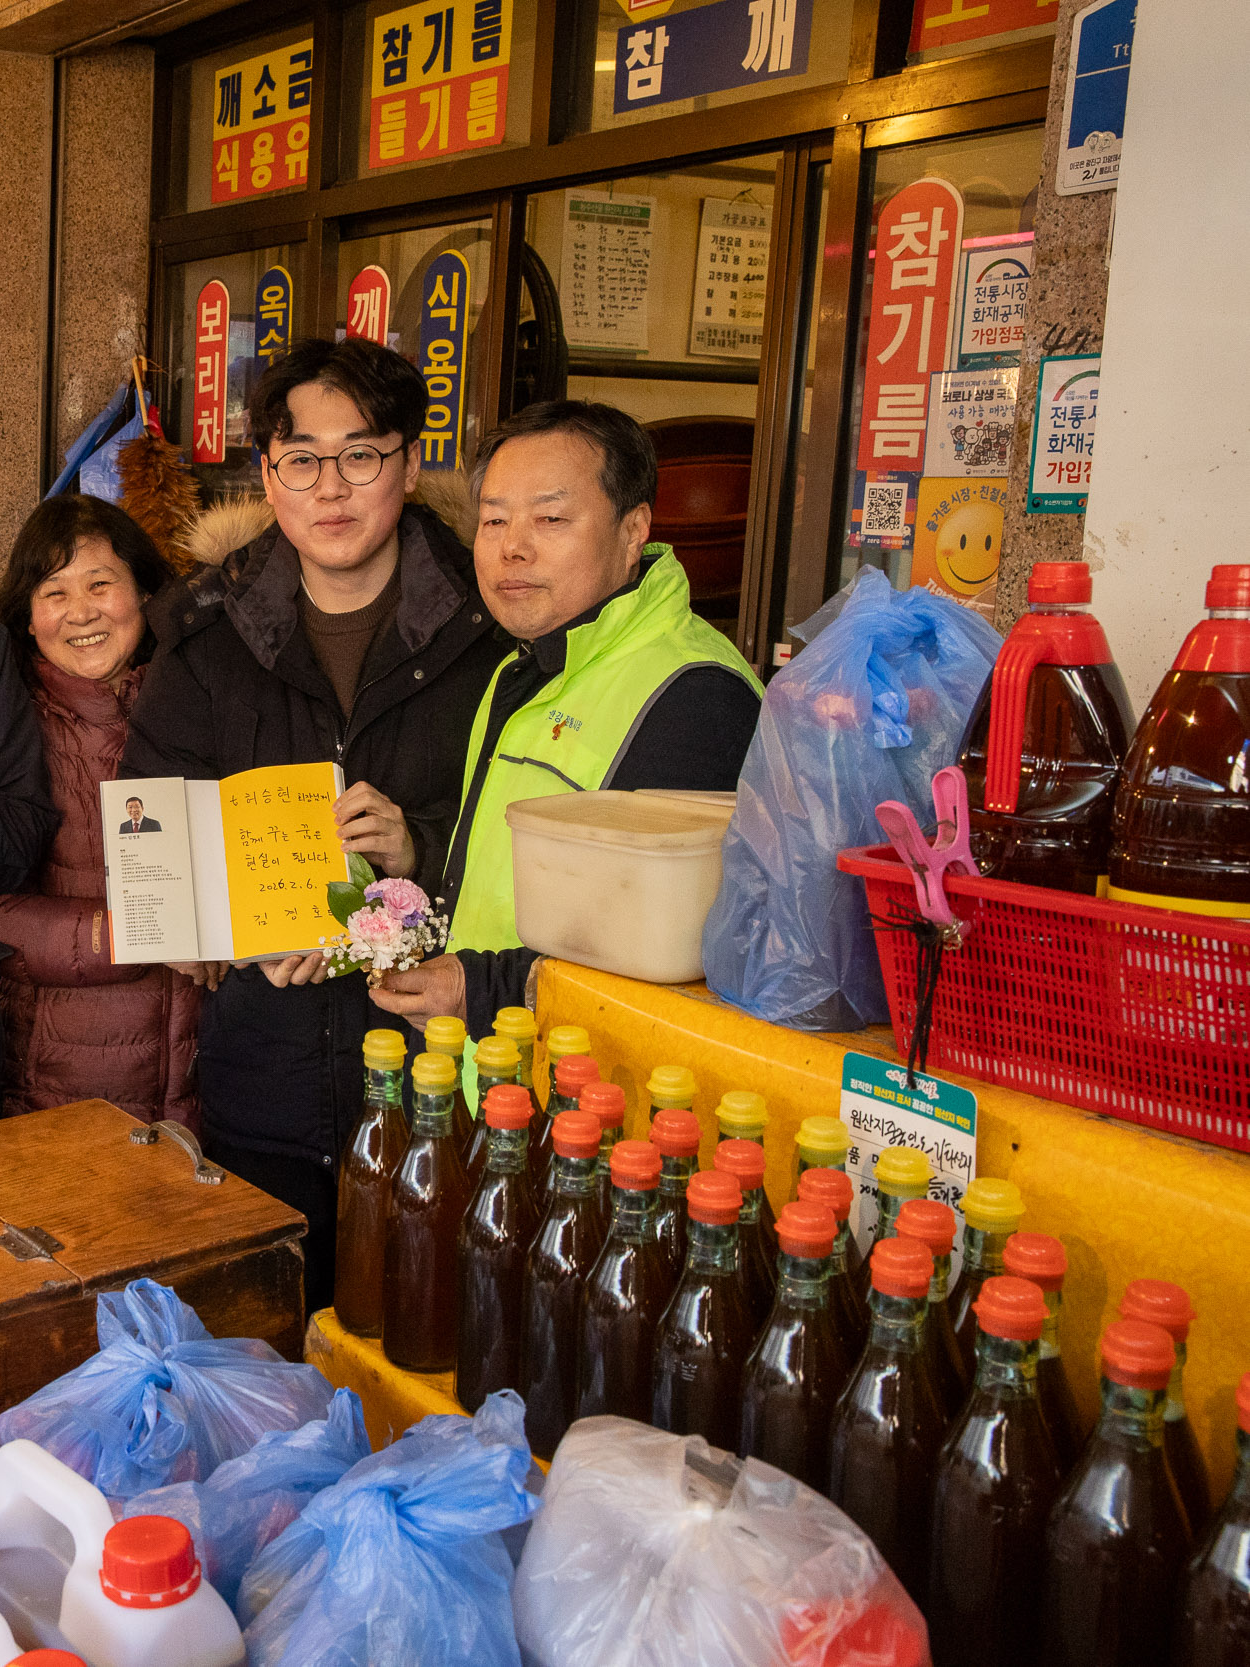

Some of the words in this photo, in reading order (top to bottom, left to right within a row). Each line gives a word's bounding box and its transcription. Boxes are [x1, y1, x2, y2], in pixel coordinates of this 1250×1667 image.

[381, 0, 502, 87] 참기름
[625, 0, 795, 102] 참깨
[217, 49, 313, 127] 깨소금
[378, 77, 499, 160] 들기름
[215, 120, 311, 193] 식용유
[258, 285, 287, 366] 옥수
[351, 286, 382, 343] 깨
[868, 207, 949, 460] 참기름
[971, 303, 1027, 324] 화재공제
[971, 325, 1025, 346] 가입점포
[196, 298, 225, 456] 보리차
[419, 272, 460, 463] 식용유
[942, 390, 972, 403] 코로나
[974, 388, 994, 401] 상생
[948, 404, 965, 420] 사용
[968, 403, 984, 418] 가능
[238, 827, 264, 847] 함께
[266, 825, 289, 843] 꾸는
[295, 823, 322, 841] 꿈은
[245, 852, 280, 871] 현실이
[850, 1109, 885, 1137] 원산지
[873, 1085, 896, 1101] 원산지
[896, 1093, 911, 1107] 표시
